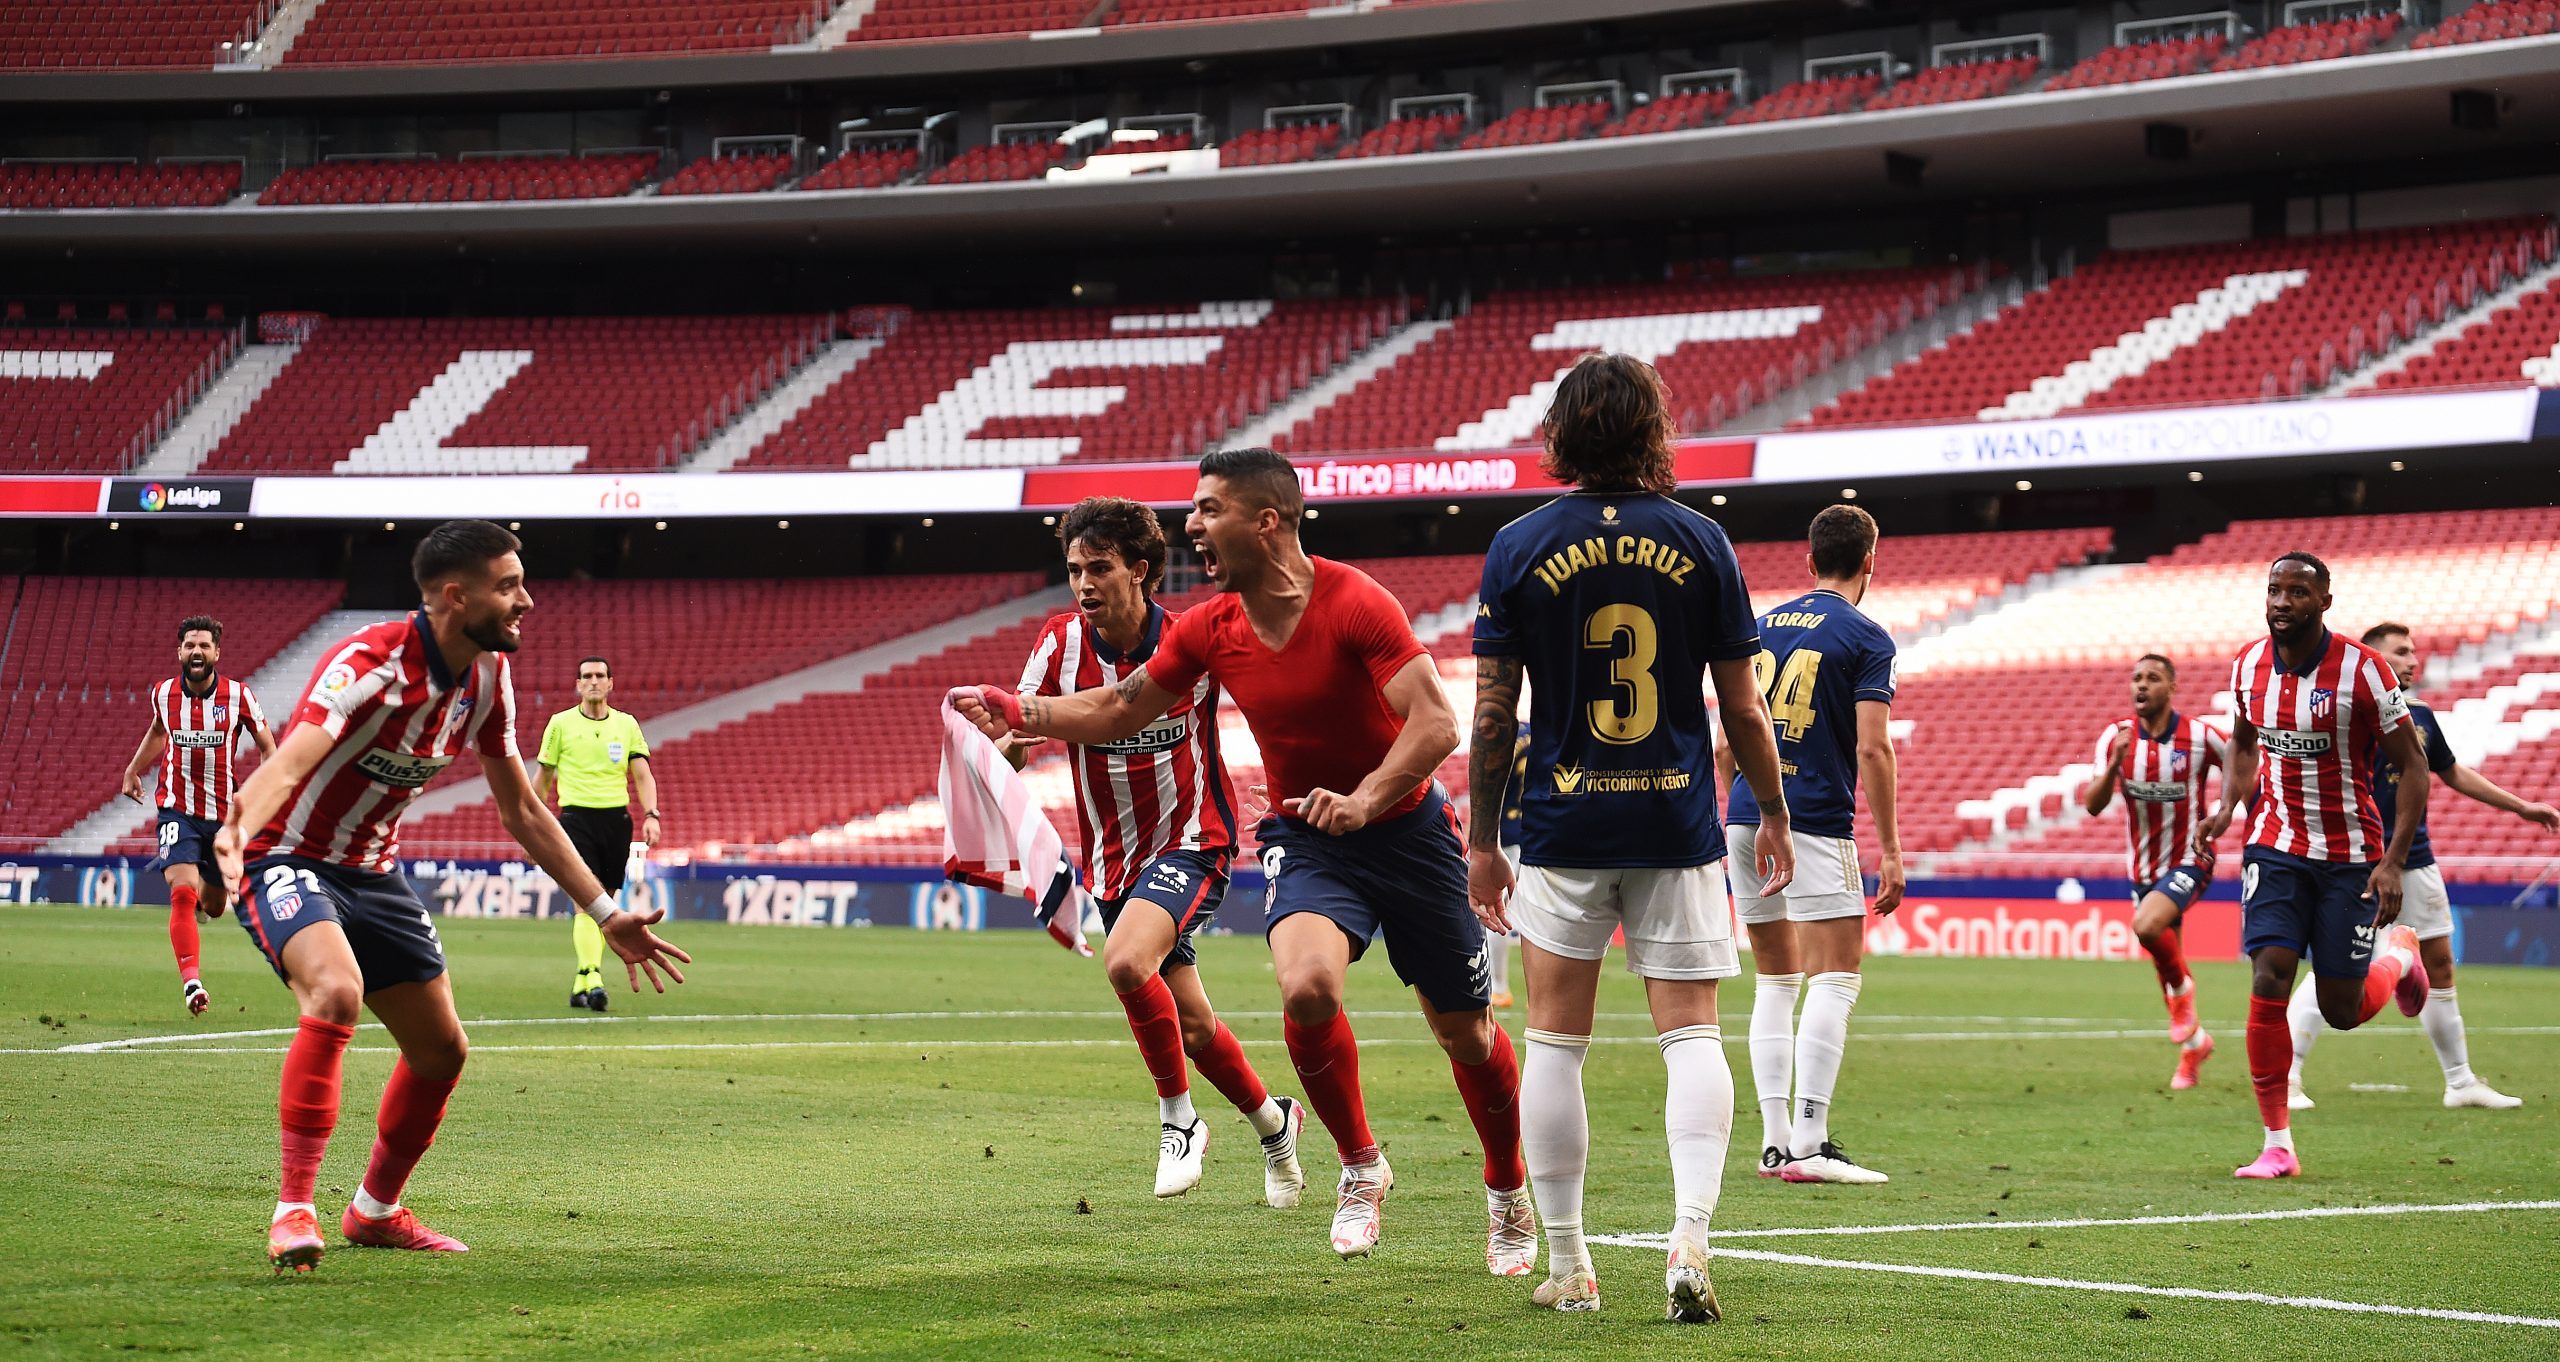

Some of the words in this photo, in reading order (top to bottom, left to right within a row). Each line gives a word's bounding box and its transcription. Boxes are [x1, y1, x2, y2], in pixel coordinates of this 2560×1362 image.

[1973, 428, 2089, 461] WANDA
[2098, 411, 2333, 455] METROPOLITANO
[1293, 460, 1394, 497] TLÉTICO
[1412, 458, 1517, 493] MADRID
[167, 486, 221, 509] LaLiga
[600, 479, 641, 508] ria
[1533, 536, 1609, 597] JUAN
[1616, 535, 1697, 586] CRUZ
[1765, 612, 1828, 630] TORRÓ
[1583, 603, 1659, 746] 3
[173, 733, 223, 744] Plus500
[1137, 746, 1162, 754] Online
[1586, 769, 1655, 778] CONSTRUCCIONES
[1586, 777, 1650, 792] VICTORINO
[159, 821, 180, 846] 18
[1152, 872, 1185, 894] VERSUS
[723, 879, 858, 928] 1XBET
